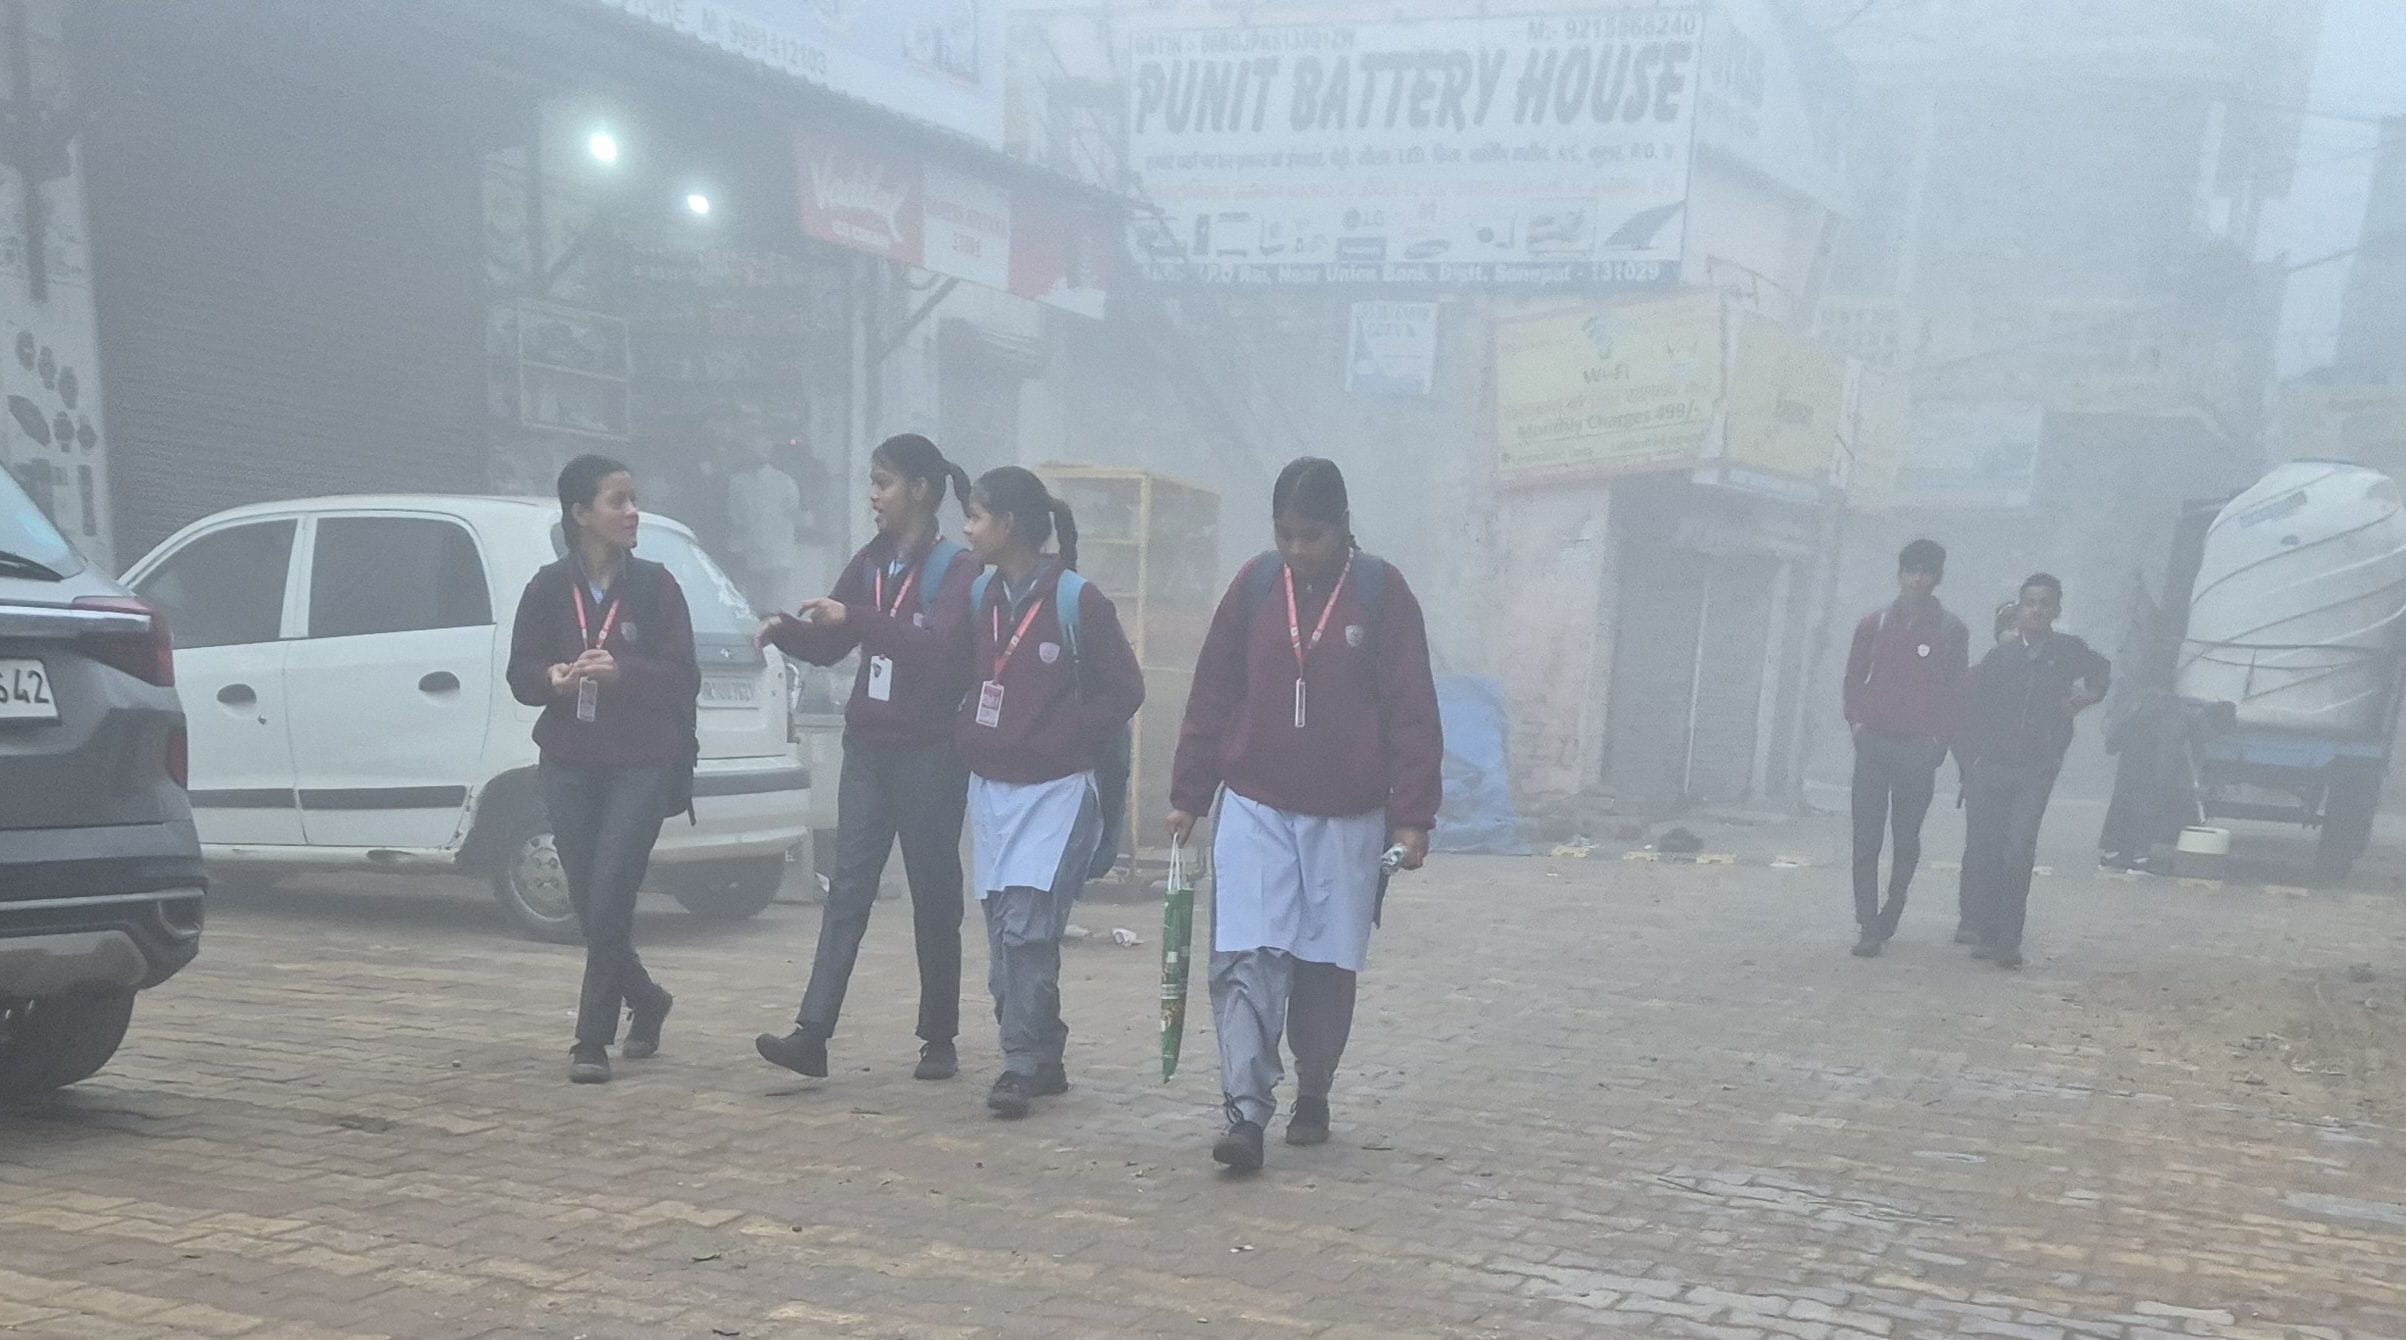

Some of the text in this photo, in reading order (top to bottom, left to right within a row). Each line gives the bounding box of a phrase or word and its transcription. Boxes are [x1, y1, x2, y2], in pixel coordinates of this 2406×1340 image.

[1136, 57, 1280, 135] PUNIT
[1290, 48, 1507, 132] BATTERY
[1514, 41, 1692, 125] HOUSE
[1325, 262, 1378, 284] Union
[1583, 362, 1630, 384] Wi-Fi
[1517, 416, 1583, 440] Monthly
[1586, 408, 1651, 429] Charges
